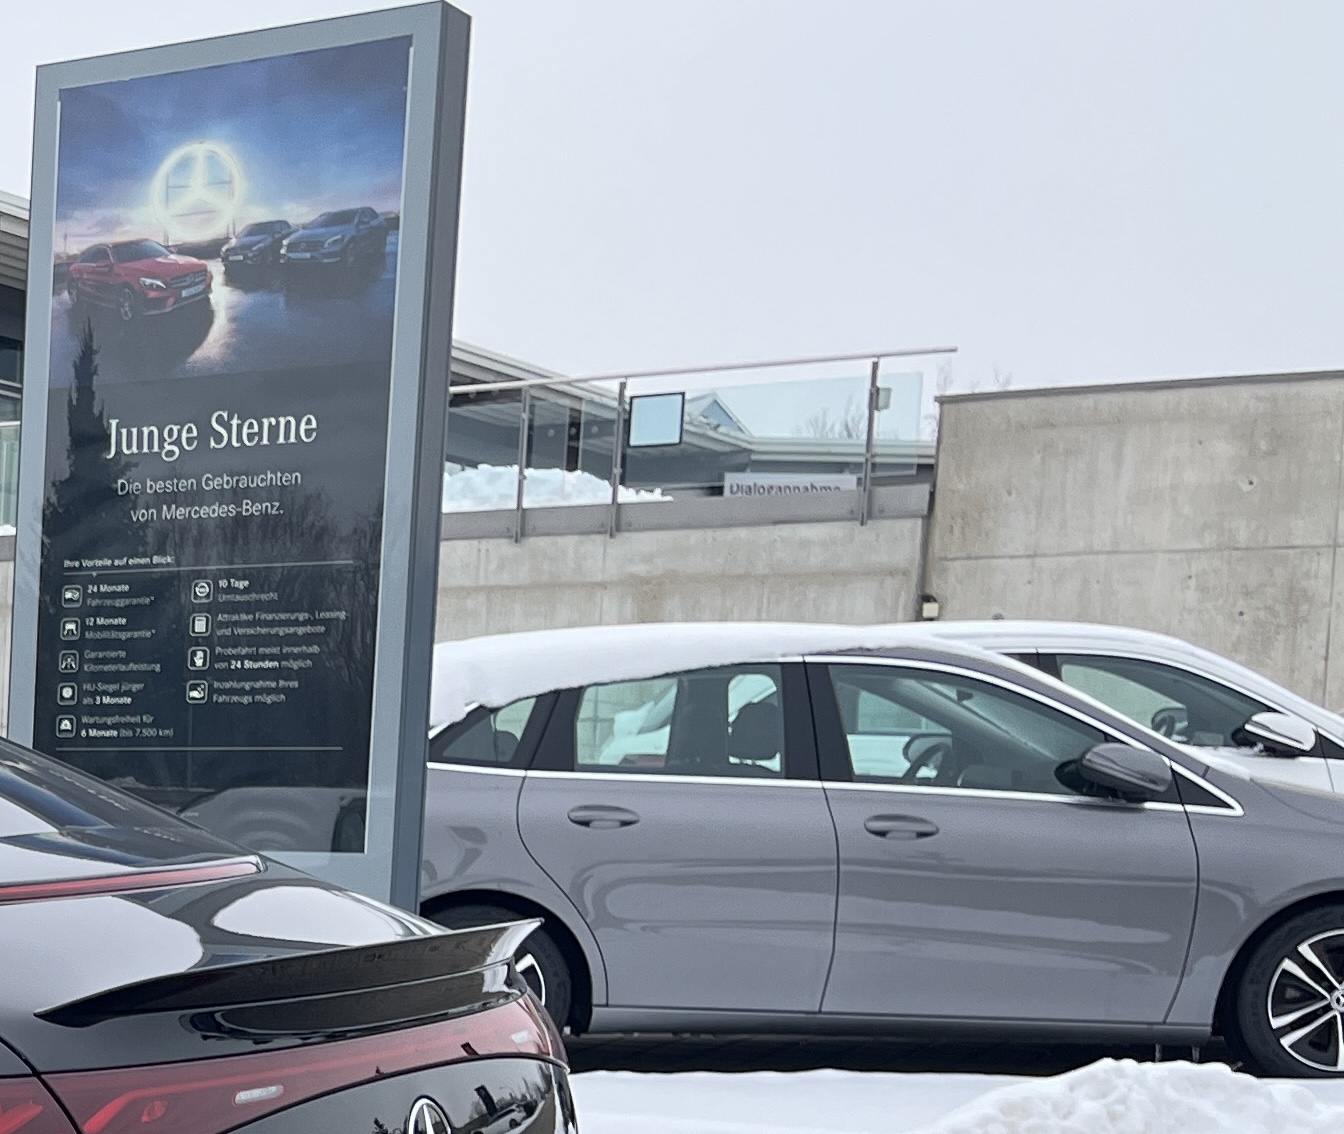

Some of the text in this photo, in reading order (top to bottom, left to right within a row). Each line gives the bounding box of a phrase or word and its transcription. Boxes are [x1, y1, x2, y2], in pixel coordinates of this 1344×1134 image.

[105, 410, 318, 462] Junge Sterne
[116, 470, 302, 496] Die besten Gebrauchten
[130, 499, 285, 523] von Mercedes-Benz.
[63, 560, 80, 569] Ihre
[81, 558, 113, 568] Vorteile
[114, 557, 127, 567] auf
[128, 557, 151, 566] einen
[87, 584, 130, 594] 24 Monate
[218, 578, 250, 590] 10 Tage
[85, 617, 127, 627] 12 Monate
[217, 612, 254, 622] Attraktive
[216, 626, 231, 636] und
[215, 646, 256, 657] Probefahrt
[282, 645, 320, 655] innerhalb
[214, 659, 313, 671] von 24 Stunden möglich
[95, 696, 101, 705] 3
[102, 696, 132, 705] Monate
[212, 693, 287, 705] Fahrzeugs möglich
[80, 728, 87, 738] 6
[88, 728, 118, 738] Monate
[135, 728, 158, 737] 7.500
[159, 727, 174, 738] km)
